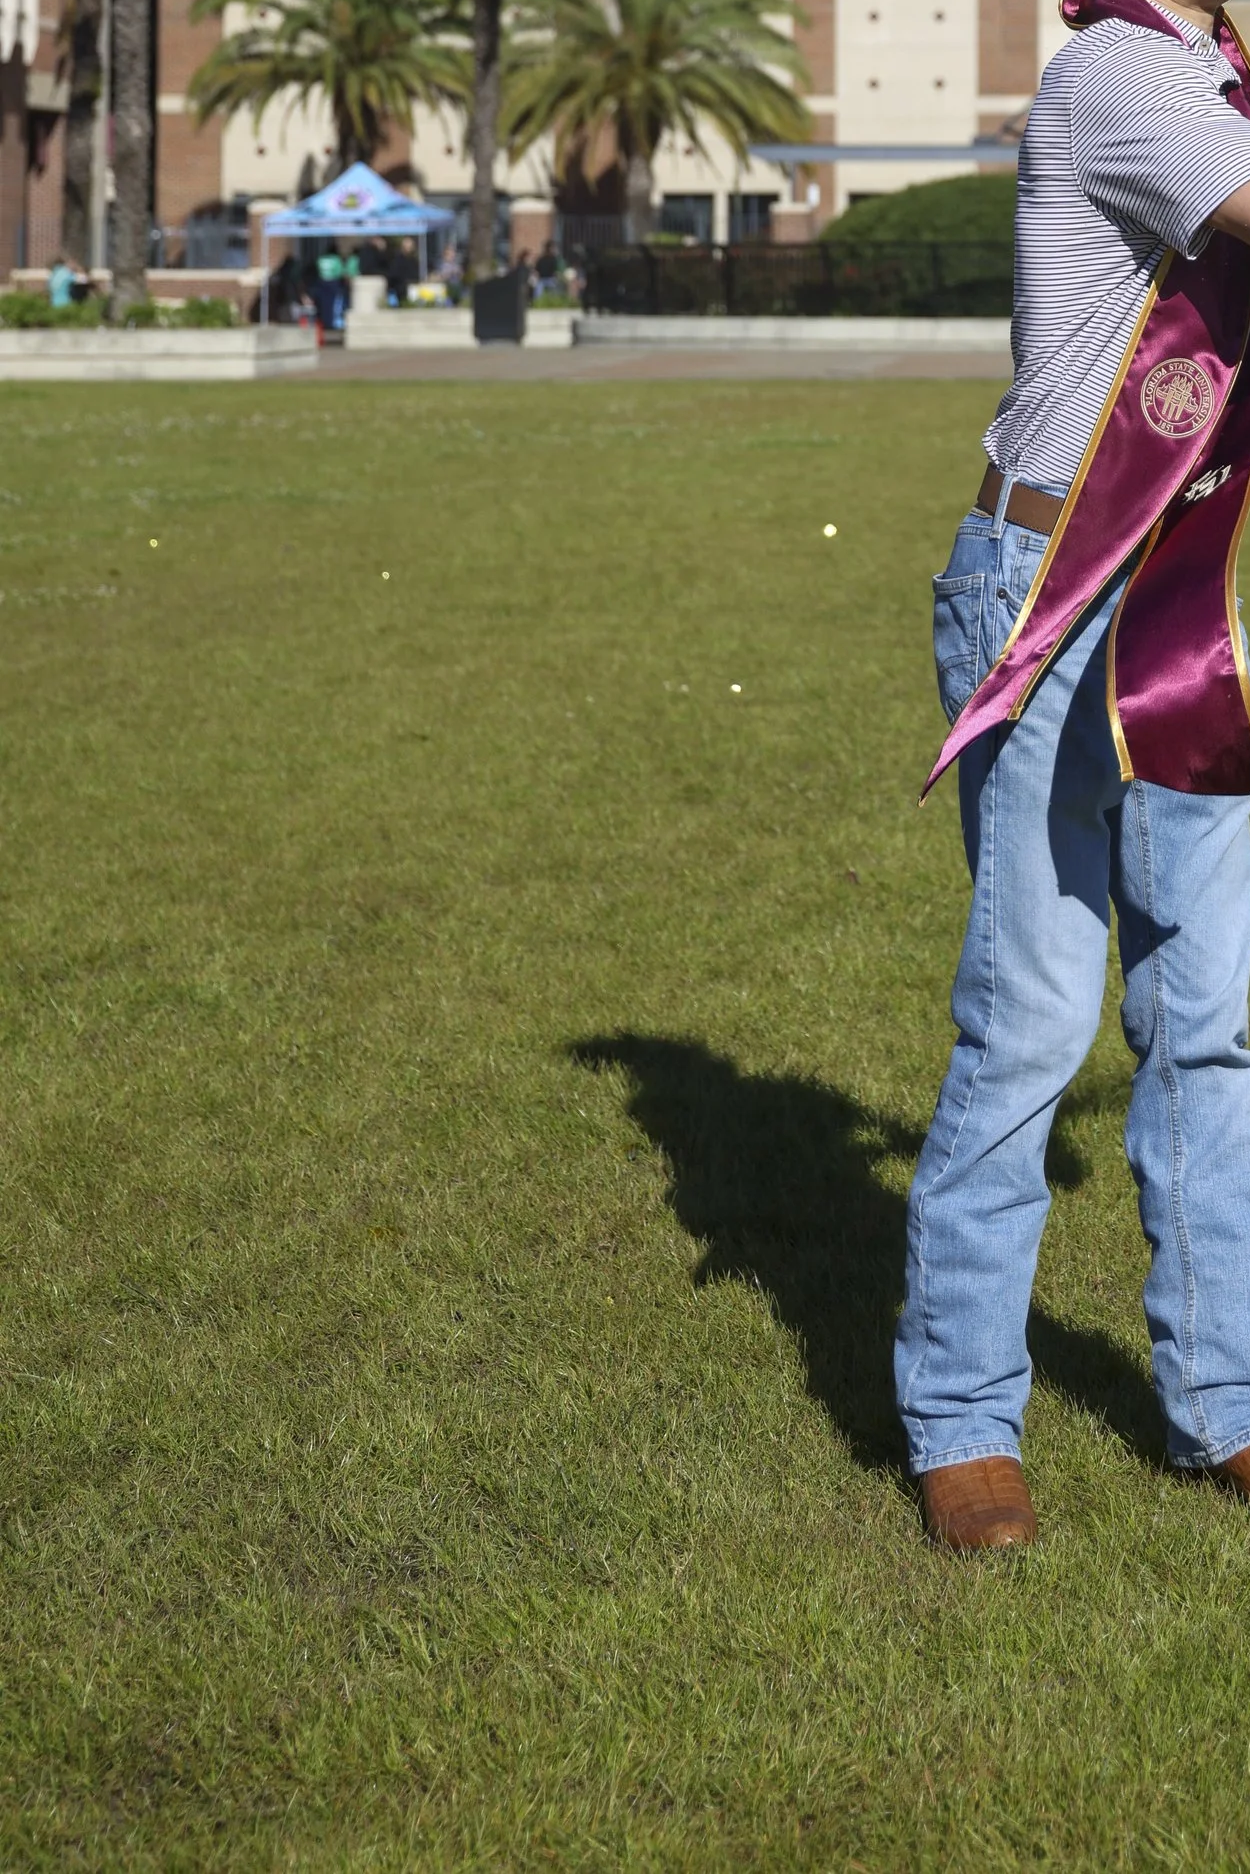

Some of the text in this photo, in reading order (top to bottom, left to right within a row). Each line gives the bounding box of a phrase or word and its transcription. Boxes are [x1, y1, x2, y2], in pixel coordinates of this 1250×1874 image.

[1145, 362, 1210, 428] FLORIDA STATE UNIVERSITY
[1157, 420, 1174, 433] 1851
